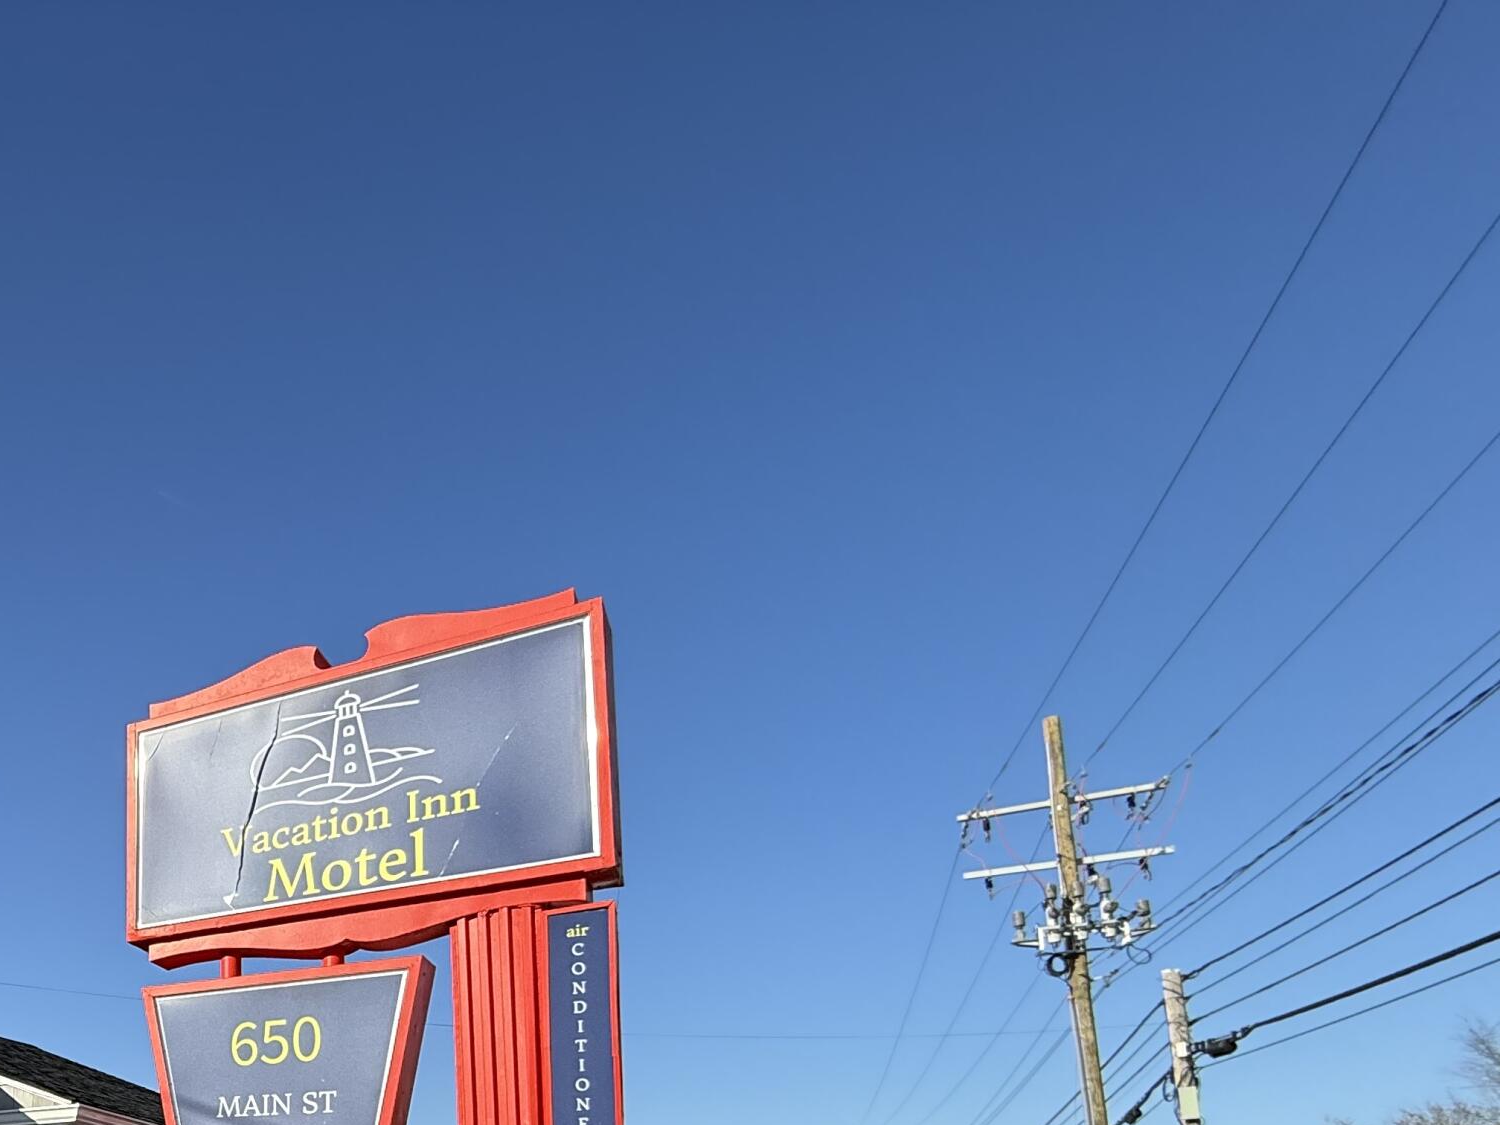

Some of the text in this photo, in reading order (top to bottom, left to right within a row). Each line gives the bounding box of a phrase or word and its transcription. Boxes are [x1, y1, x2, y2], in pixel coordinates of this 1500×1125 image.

[221, 787, 481, 857] Vacation Inn
[263, 827, 429, 902] Motel
[566, 924, 590, 938] air
[231, 1016, 321, 1067] 650
[216, 1090, 337, 1118] MAIN ST
